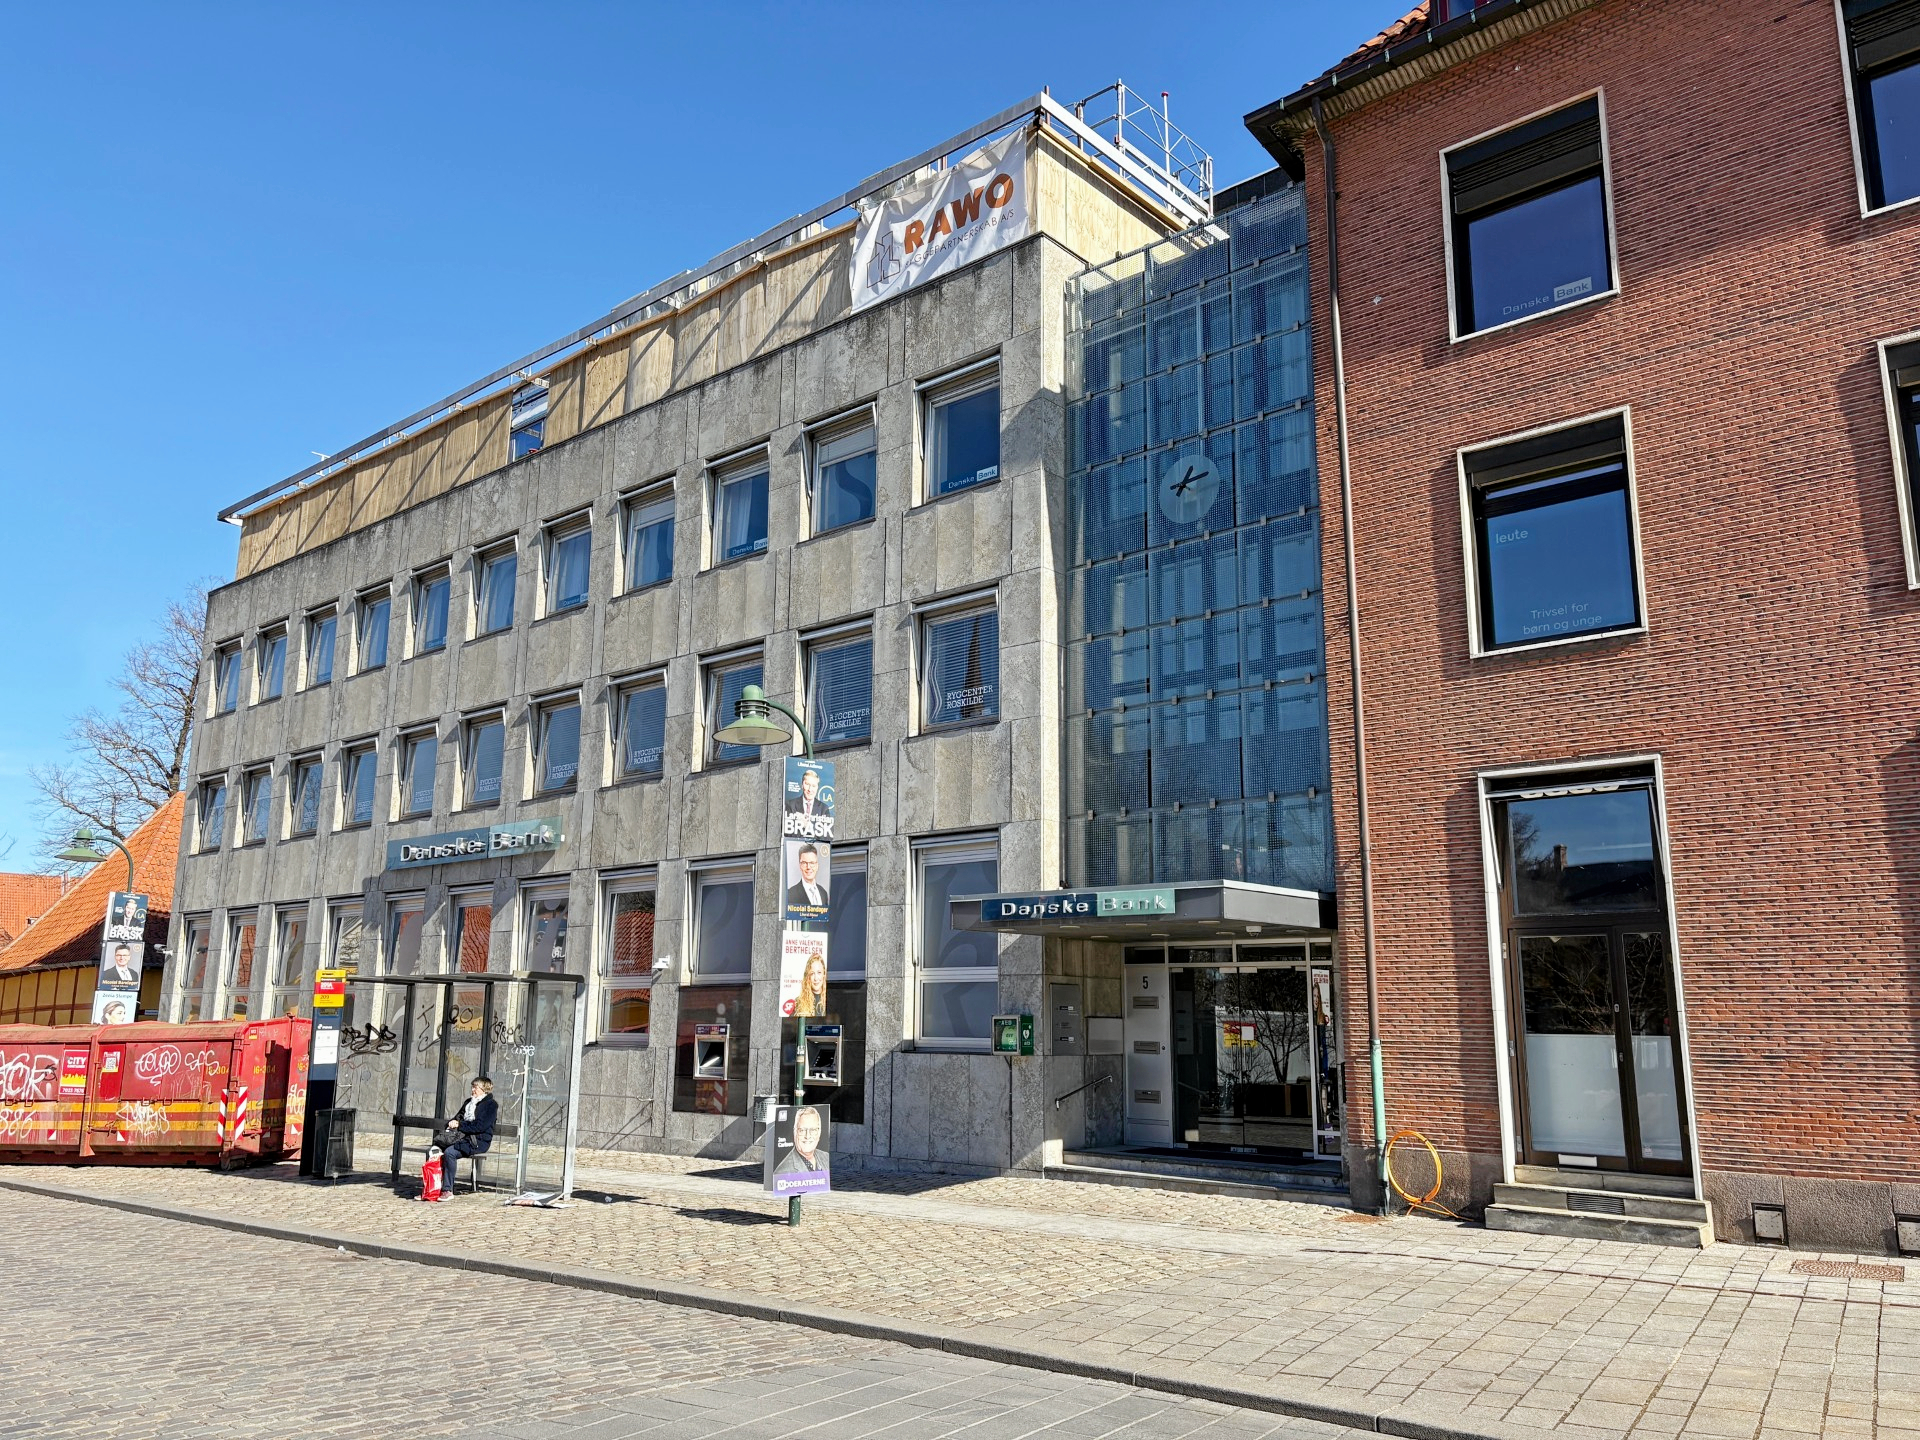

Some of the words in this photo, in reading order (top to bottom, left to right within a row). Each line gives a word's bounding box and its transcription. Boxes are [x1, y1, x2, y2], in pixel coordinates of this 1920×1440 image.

[904, 173, 1014, 254] RAWO
[1000, 208, 1015, 223] A/S
[1502, 295, 1550, 315] Danske
[1556, 282, 1589, 299] Bank
[948, 476, 975, 489] Danske
[978, 468, 996, 480] Bank
[1495, 529, 1529, 544] leute
[1530, 604, 1568, 620] Trivsel
[1571, 603, 1589, 614] for
[1523, 624, 1550, 635] børn
[1553, 620, 1569, 631] og
[1572, 615, 1602, 628] unge
[946, 685, 994, 701] RYGCENTER
[946, 696, 984, 710] ROSKILDE
[829, 708, 871, 722] RYGCENTER
[829, 718, 862, 730] ROSKILDE
[822, 793, 833, 802] LA
[784, 819, 834, 838] BRASK
[400, 838, 482, 862] Danske
[490, 825, 553, 850] Bank
[787, 904, 807, 912] Nicolai
[1001, 899, 1089, 916] Danske
[1102, 895, 1167, 912] Bank
[109, 929, 143, 941] BRASK
[785, 946, 823, 955] BERTHELSEN
[1142, 976, 1149, 989] 5
[785, 1002, 793, 1011] SF
[67, 1057, 87, 1066] CITY
[777, 1177, 826, 1192] MODERATERNE
